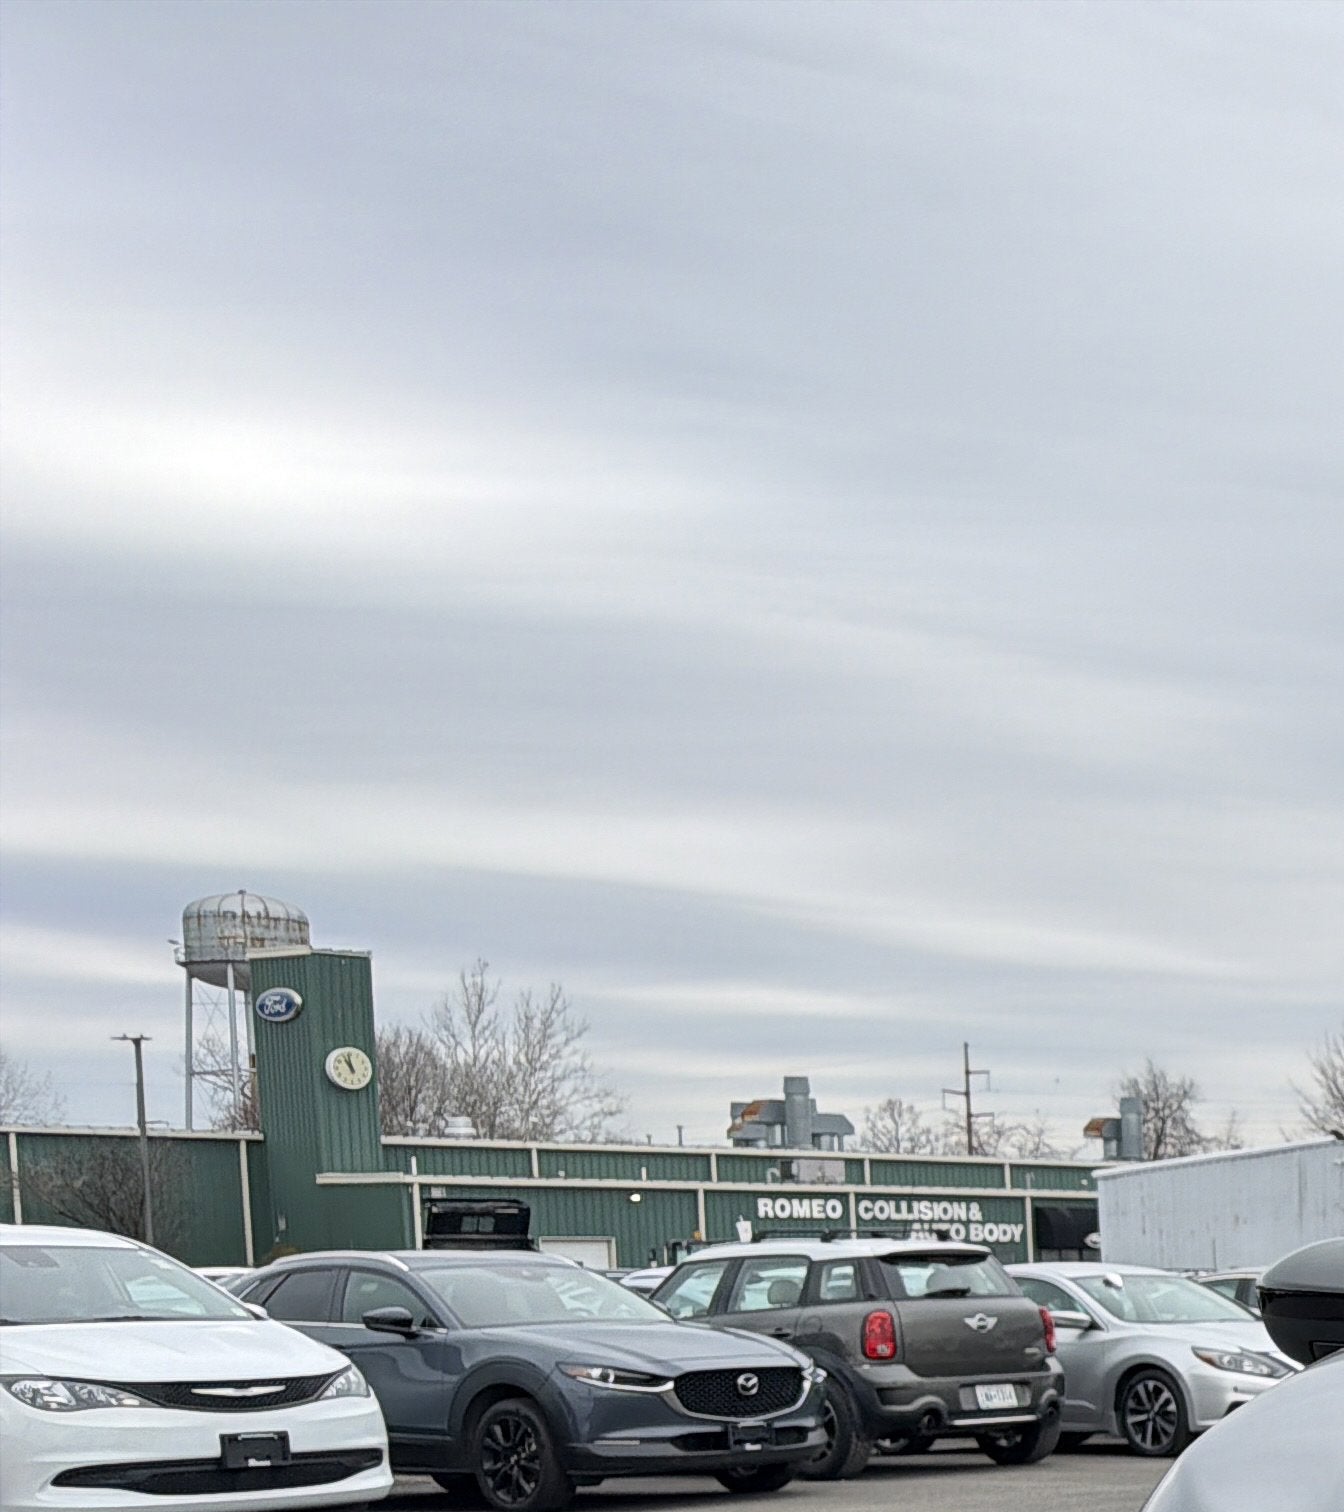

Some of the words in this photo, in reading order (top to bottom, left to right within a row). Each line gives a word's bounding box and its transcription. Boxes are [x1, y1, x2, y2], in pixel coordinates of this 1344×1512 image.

[757, 1198, 843, 1219] ROMEO
[857, 1200, 967, 1221] COLLISION
[969, 1222, 1024, 1243] BODY
